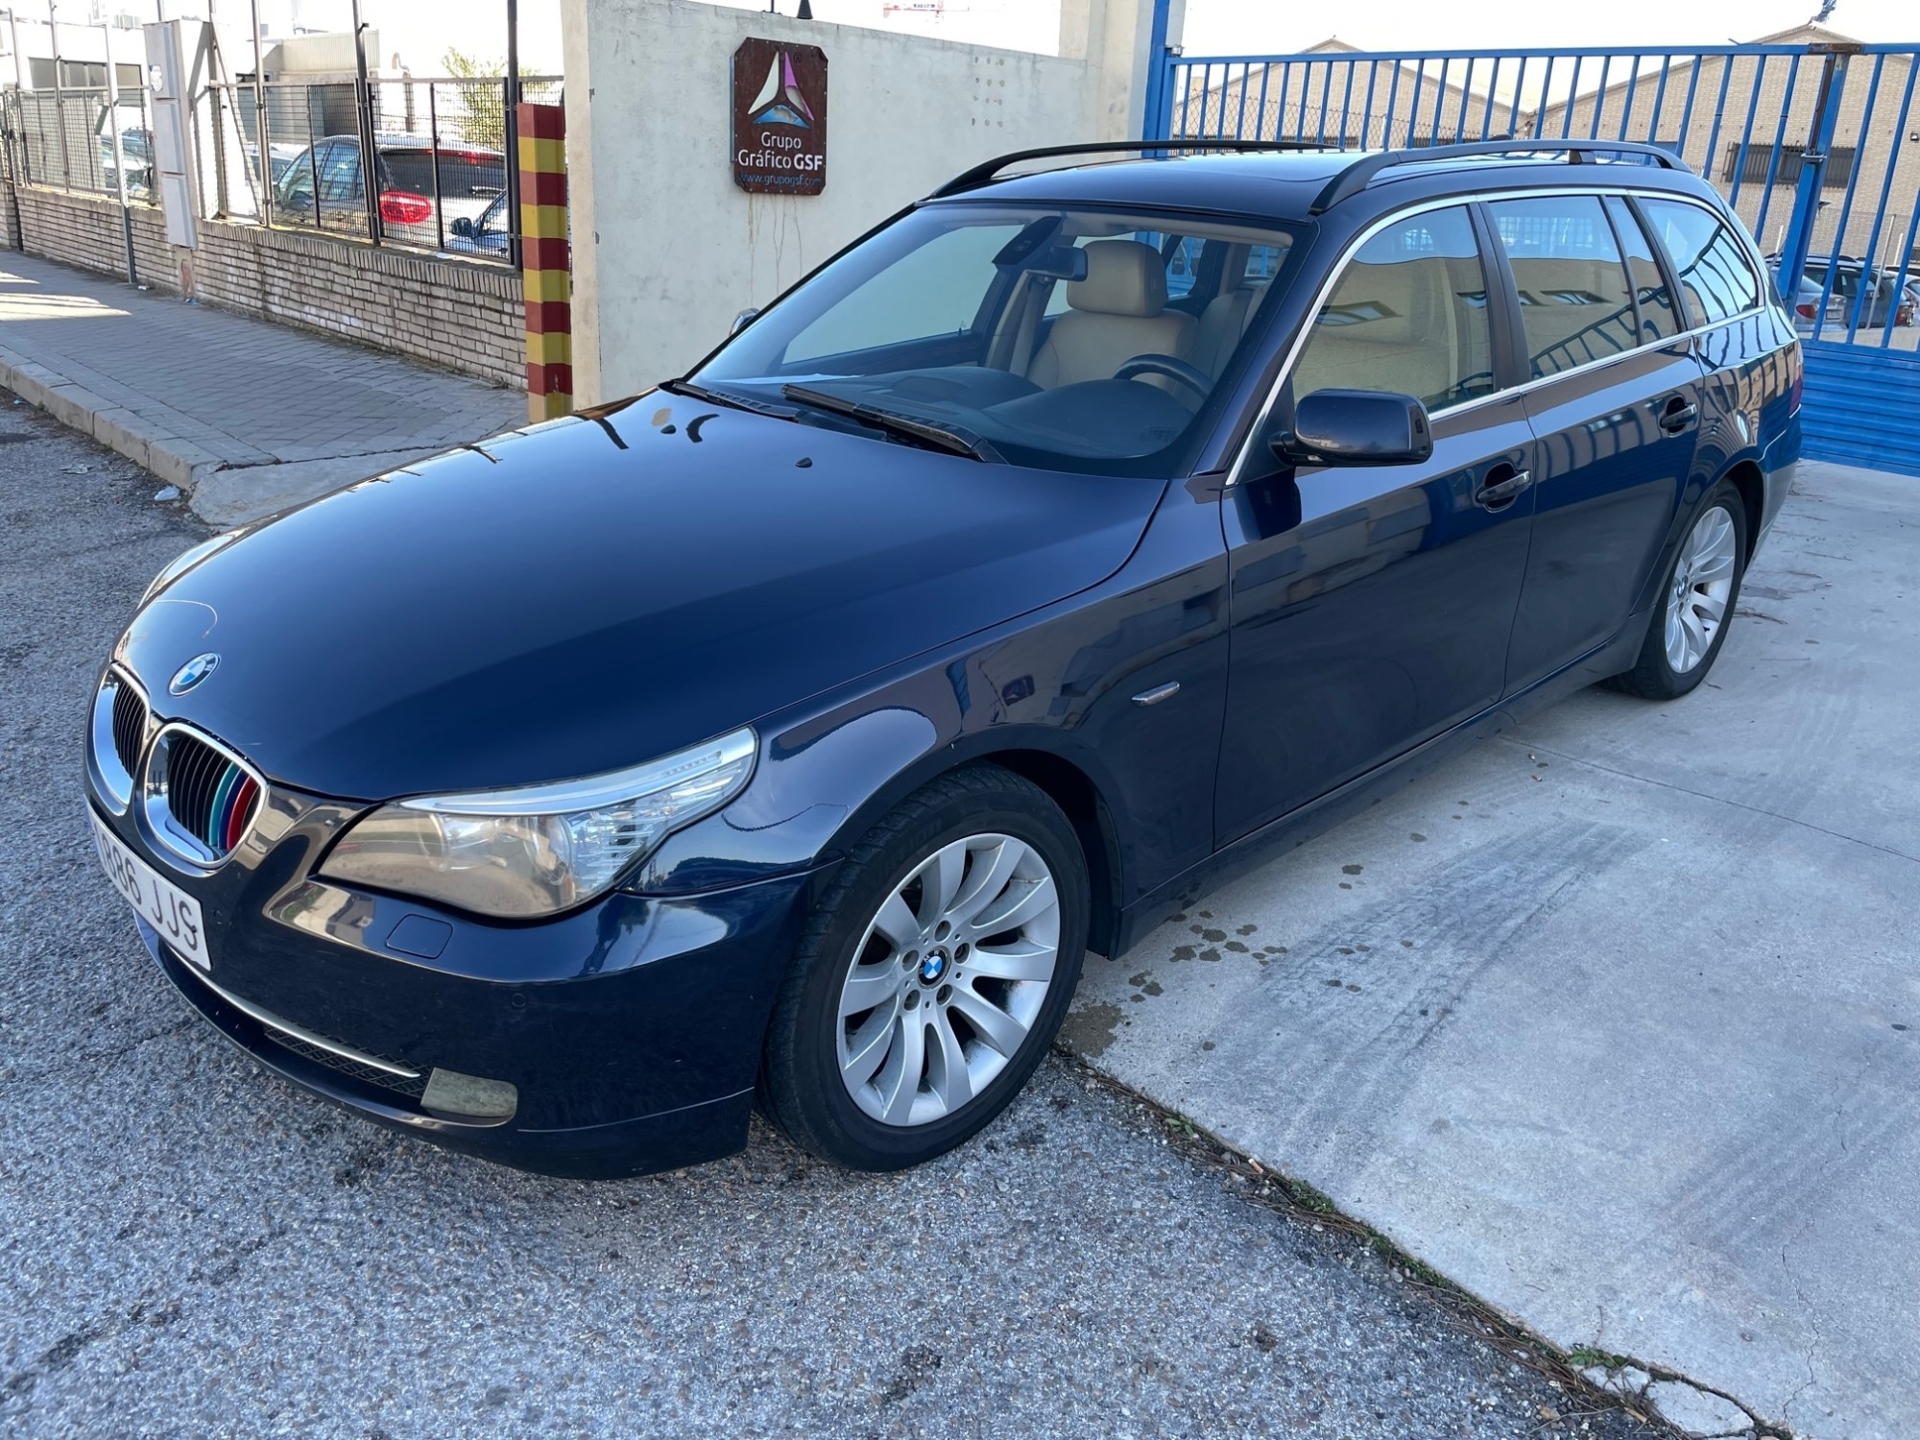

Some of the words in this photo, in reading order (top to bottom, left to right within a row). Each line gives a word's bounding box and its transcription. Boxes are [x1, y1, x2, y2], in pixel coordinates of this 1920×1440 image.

[761, 131, 802, 151] Grupo
[738, 149, 792, 169] Gráfico
[794, 153, 823, 171] GSF
[151, 879, 198, 951] JJS
